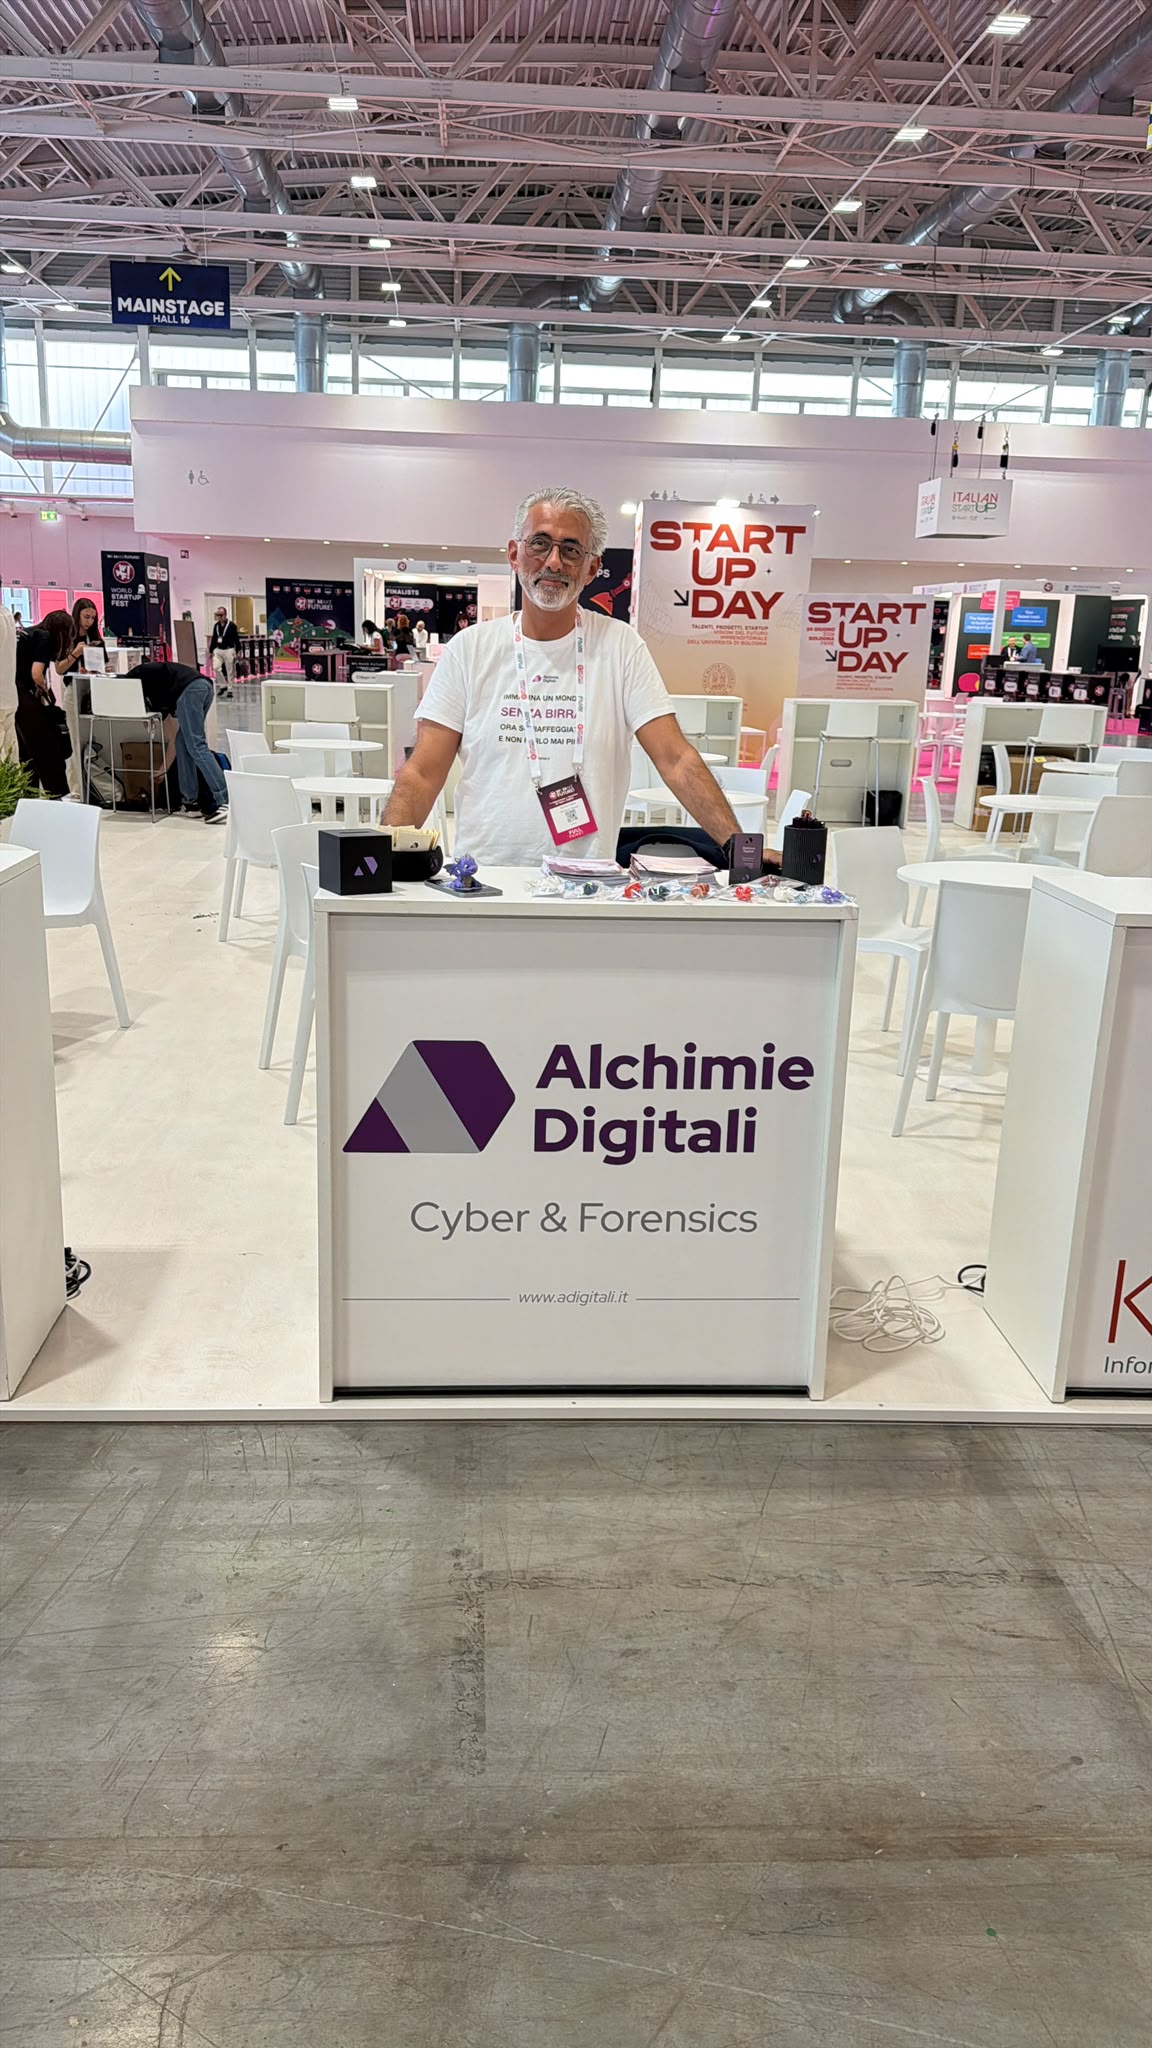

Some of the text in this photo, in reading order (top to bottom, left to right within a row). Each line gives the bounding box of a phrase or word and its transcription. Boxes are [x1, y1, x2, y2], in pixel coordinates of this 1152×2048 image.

[117, 296, 225, 316] MAINSTAGE
[153, 314, 190, 325] HALL 16
[952, 491, 998, 503] ITALIAN
[650, 520, 807, 554] START
[691, 547, 756, 586] UP
[111, 593, 142, 601] STARTUP
[386, 588, 419, 596] FINALISTS
[691, 589, 785, 620] DAY
[808, 601, 927, 625] START
[838, 620, 888, 648] UP
[837, 651, 909, 673] DAY
[503, 693, 541, 702] IMMINA
[545, 708, 577, 719] BIRR
[498, 735, 504, 743] E
[505, 736, 523, 744] NON
[535, 1041, 815, 1091] Alchimie
[533, 1105, 758, 1165] Digitali
[410, 1201, 758, 1241] Cyber & Forensics
[518, 1290, 629, 1306] www.adigitali.it
[1104, 1355, 1152, 1374] Info
